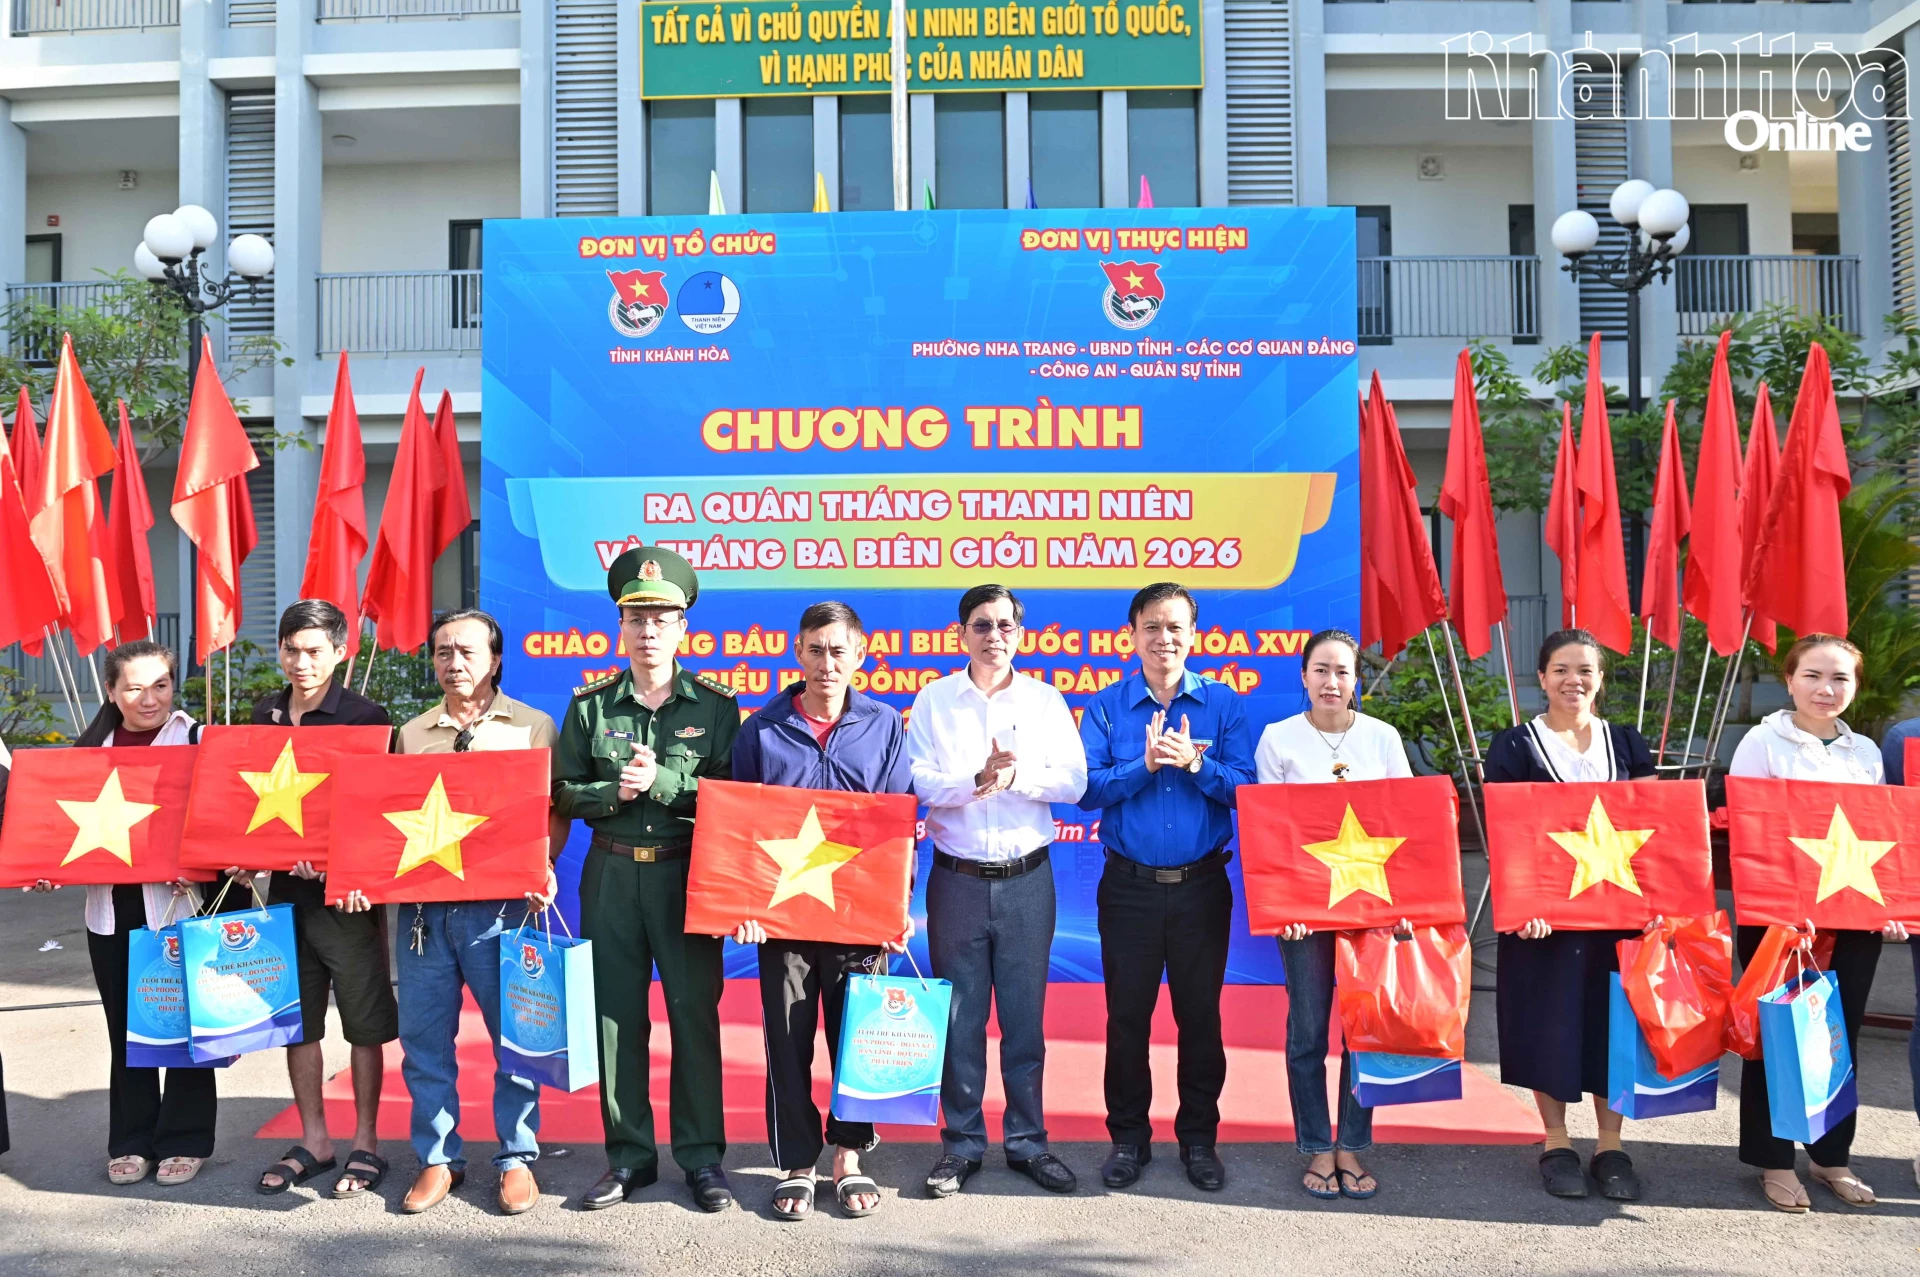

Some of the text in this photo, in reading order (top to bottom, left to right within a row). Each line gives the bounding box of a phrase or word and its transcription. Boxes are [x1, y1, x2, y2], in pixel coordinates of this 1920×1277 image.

[651, 2, 1191, 44] TẤT CẢ VÌ CHỦ QUYỀN N NINH BIÊN GIỚI TỔ QUỐC,
[760, 50, 781, 84] VÌ
[787, 53, 847, 88] HẠNH
[919, 42, 964, 81] CỦA
[970, 45, 1032, 79] NHÂN
[1038, 44, 1084, 78] DÂN
[580, 230, 773, 258] ĐƠN VỊ TỔ CHỨC
[1022, 227, 1245, 252] ĐƠN VỊ THỰC HIỆN
[609, 345, 730, 363] TỈNH KHÁNH HÒA
[913, 339, 981, 356] PHƯỜNG
[985, 342, 1019, 356] NHA
[1023, 342, 1076, 356] TRANG
[1089, 342, 1133, 356] UBND
[1136, 337, 1172, 355] TỈNH
[1185, 338, 1222, 355] CÁC
[1226, 340, 1253, 355] CƠ
[1257, 341, 1303, 355] QUAN
[1307, 336, 1355, 355] ĐẢNG
[1039, 360, 1090, 377] CÔNG
[1093, 364, 1117, 377] AN
[1130, 360, 1177, 377] QUÂN
[1181, 362, 1202, 380] SỰ
[1204, 359, 1240, 377] TỈNH
[703, 398, 1140, 451] CHƯƠNG TRÌNH
[646, 487, 1190, 524] RA QUÂN THÁNG THANH NIÊN
[596, 537, 640, 568] V
[797, 541, 845, 567] BA
[856, 534, 939, 566] BIÊN
[953, 533, 1035, 566] GIỚI
[1049, 535, 1135, 565] NĂM
[1147, 539, 1239, 566] 2026
[525, 630, 608, 655] CHÀO
[725, 627, 785, 654] BẦU
[1016, 625, 1079, 653] UỐC
[1091, 628, 1136, 659] HỘ
[585, 668, 617, 684] V
[1055, 667, 1120, 692] DÂN
